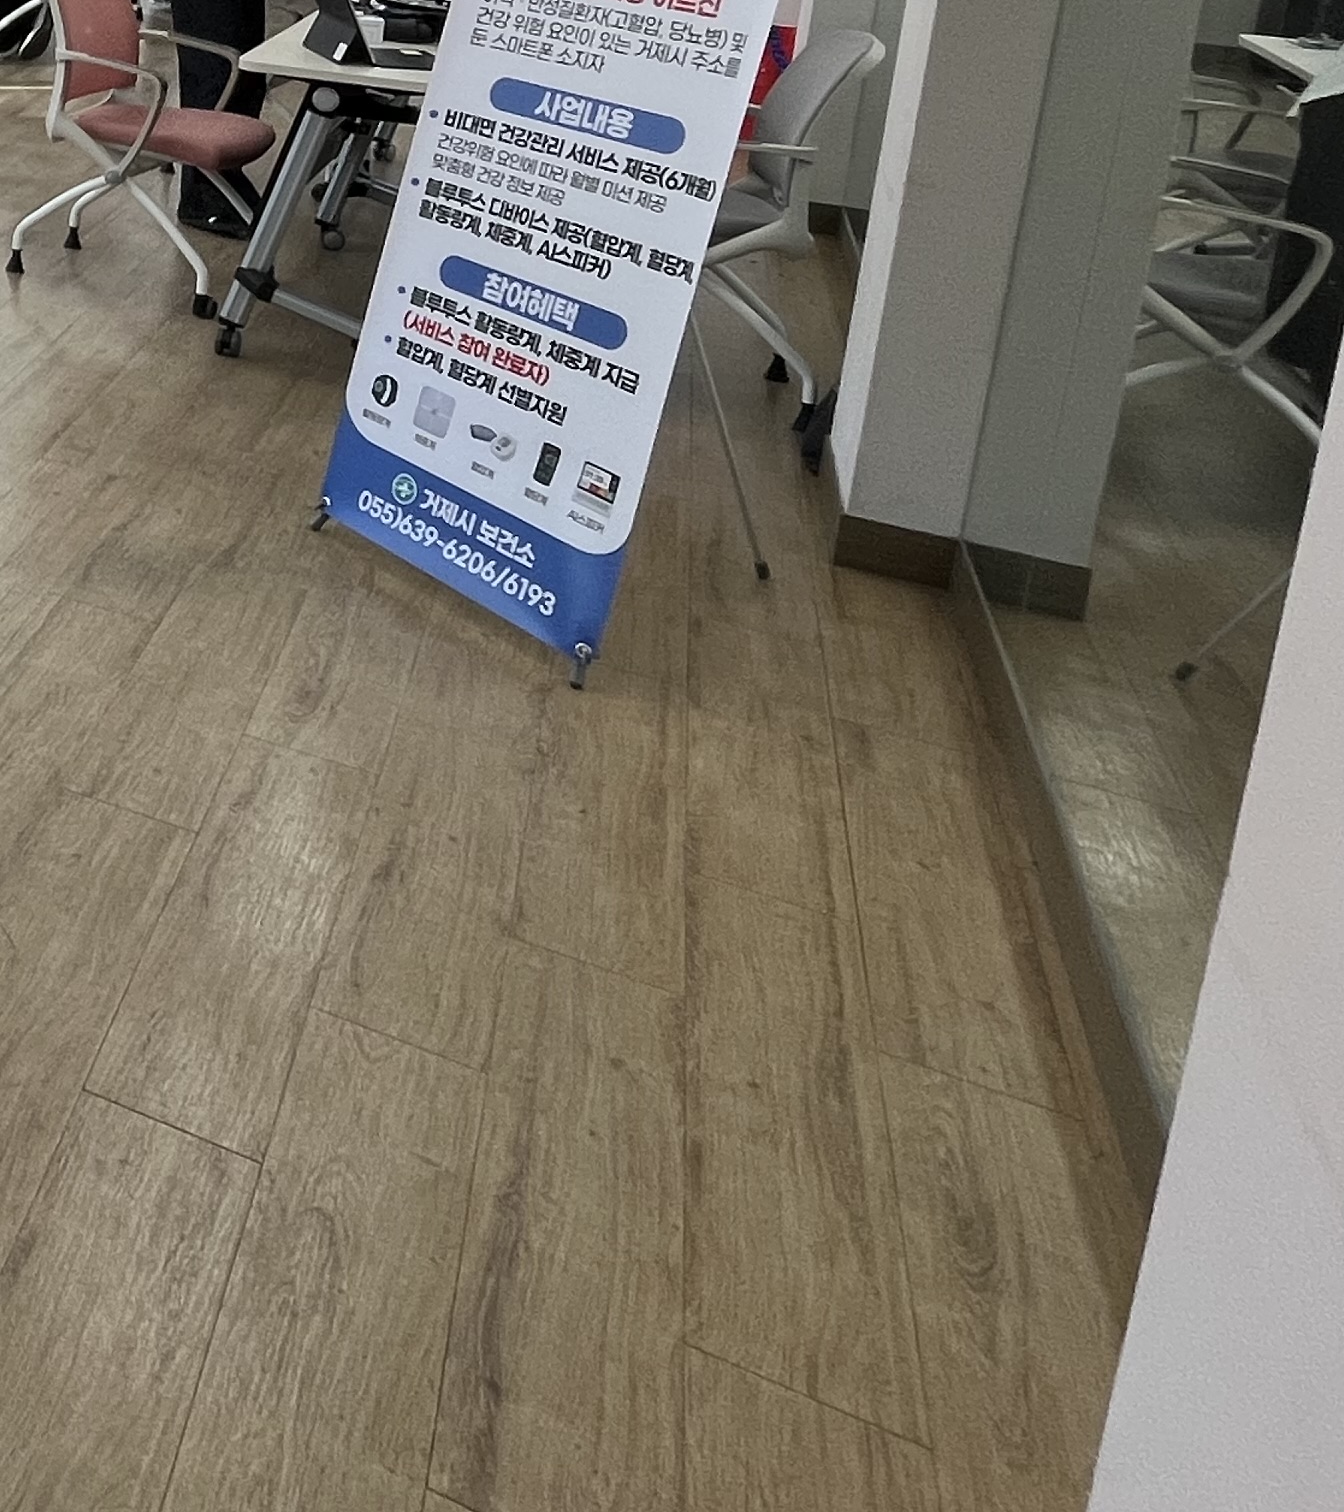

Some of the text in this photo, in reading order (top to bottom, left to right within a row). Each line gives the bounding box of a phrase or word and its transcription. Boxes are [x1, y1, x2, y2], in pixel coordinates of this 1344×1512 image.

[470, 27, 606, 74] 둔 스마트폰 소지자
[476, 6, 742, 78] 건강 위험 요인이 있는 거제시 주소를
[668, 21, 728, 49] 당뇨병)
[730, 32, 749, 54] 및
[533, 90, 636, 139] 사업내용
[443, 109, 717, 202] 비대면 건강관리 서비스 제공(6개월)
[476, 166, 505, 188] 건강
[506, 174, 535, 197] 정보
[535, 184, 566, 207] 제공
[495, 150, 538, 175] 요인에
[538, 161, 568, 184] 따라
[601, 180, 634, 204] 미션
[633, 190, 667, 214] 제공
[425, 178, 486, 212] 블루투스
[489, 197, 550, 233] 디바이스
[536, 240, 612, 280] AI스피커)
[481, 272, 580, 332] 참여혜택
[403, 310, 550, 387] (서비스 참여 완료자)
[410, 286, 472, 326] 블루투스
[545, 339, 602, 378] 체중계
[601, 362, 640, 395] 지급
[447, 358, 498, 395] 혈당계
[498, 381, 568, 427] 선별지원
[358, 490, 557, 617] 055)639-6206/6193
[419, 488, 477, 536] 거제시
[475, 519, 537, 569] 보건소
